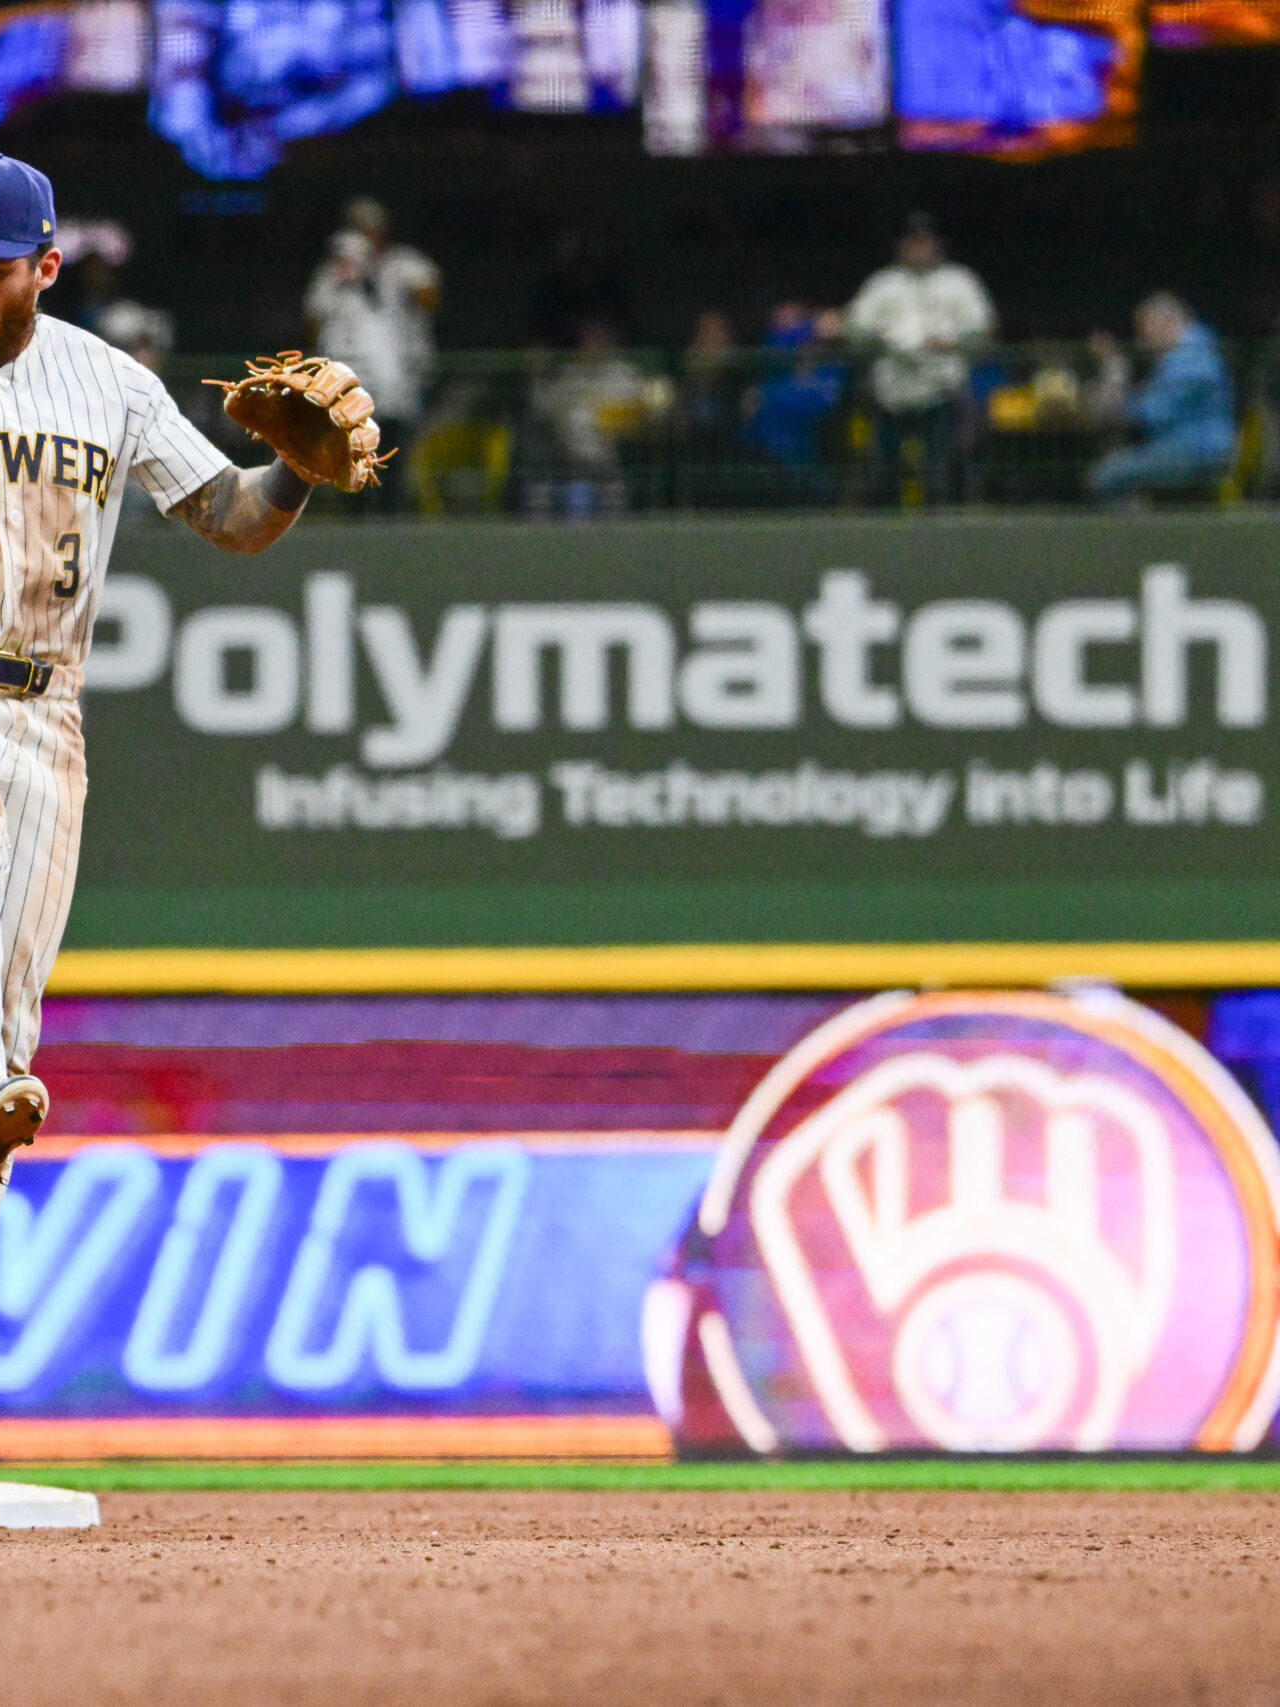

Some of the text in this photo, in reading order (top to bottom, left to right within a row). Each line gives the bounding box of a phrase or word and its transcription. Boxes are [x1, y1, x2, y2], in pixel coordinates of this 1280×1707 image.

[54, 531, 82, 601] 3
[82, 563, 1269, 769] Polymatech
[254, 757, 1266, 838] Infusing Technology into Life
